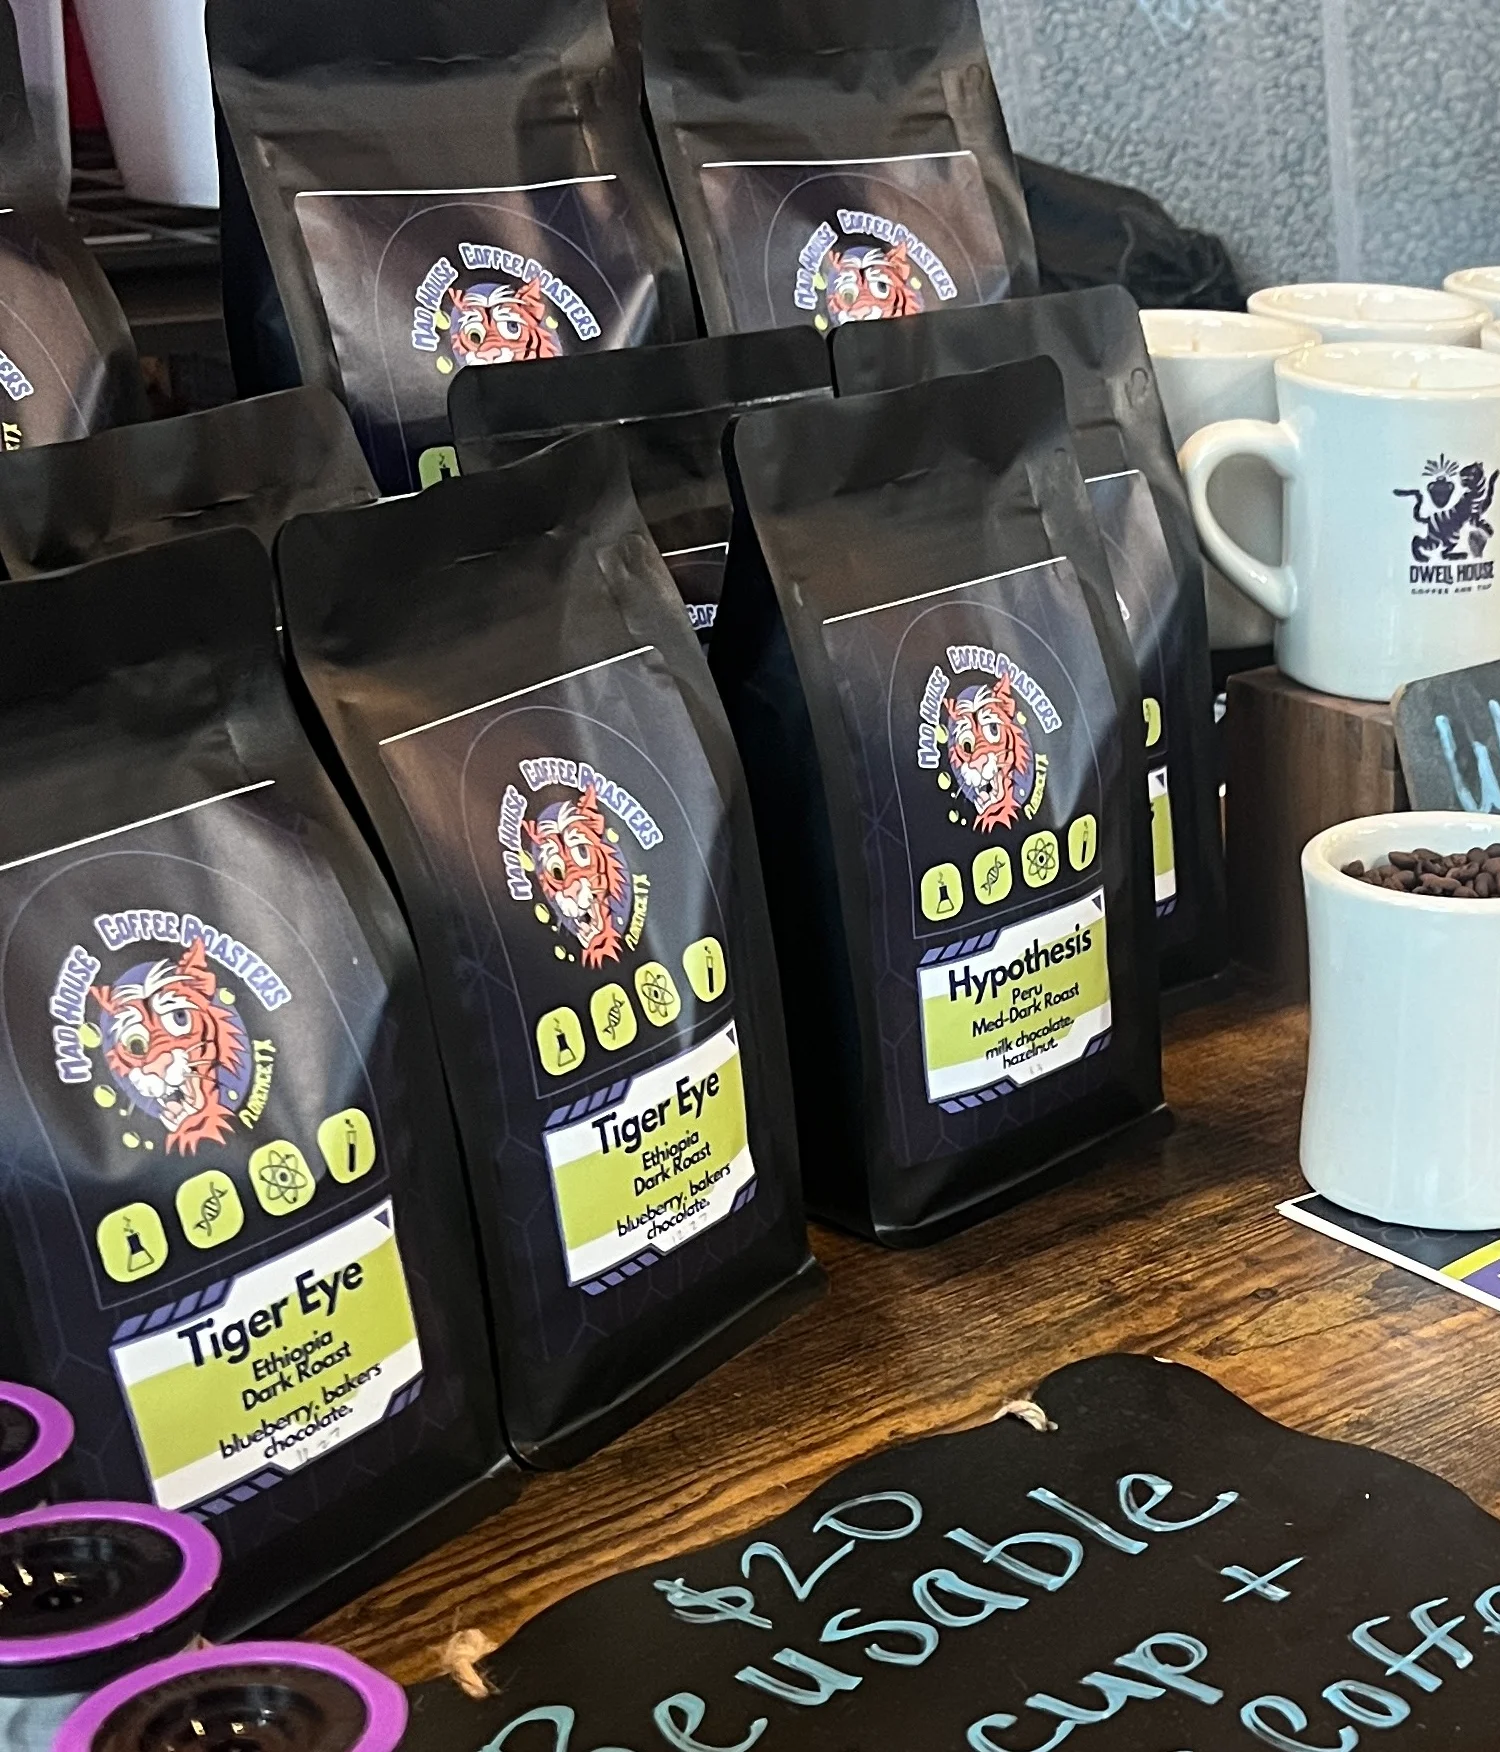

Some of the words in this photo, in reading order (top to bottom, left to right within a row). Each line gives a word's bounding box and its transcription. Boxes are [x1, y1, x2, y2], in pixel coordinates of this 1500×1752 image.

[415, 257, 459, 311] HOUSE
[458, 242, 525, 278] COFFEE
[522, 258, 602, 341] ROASTERS
[412, 306, 438, 351] MAD
[1409, 563, 1453, 585] DWELL
[1456, 561, 1494, 583] HOUSE
[946, 645, 997, 674] COFFEE
[920, 665, 950, 726] HOUSE
[994, 653, 1063, 734] ROASTERS
[918, 723, 940, 769] MAD
[519, 757, 579, 791] COFFEE
[498, 784, 528, 851] HOUSE
[577, 762, 664, 850] ROASTERS
[502, 850, 533, 900] MAD
[94, 909, 182, 951] COFFEE
[49, 945, 101, 1027] HOUSE
[180, 914, 292, 1012] ROASTERS
[949, 923, 1092, 1005] Hypothesis
[973, 999, 1042, 1037] Med-Dark
[1044, 982, 1080, 1009] Roast
[1012, 984, 1043, 1005] Peru
[53, 1025, 92, 1084] MAD
[986, 1037, 1014, 1060] milk
[591, 1098, 671, 1154] Tiger
[676, 1072, 720, 1119] Eye
[634, 1164, 670, 1197] Dark
[673, 1142, 712, 1176] Roast
[642, 1129, 700, 1172] Ethiopia
[689, 1163, 731, 1197] bakers
[178, 1298, 289, 1367] Tiger
[295, 1261, 364, 1317] Eye
[242, 1371, 294, 1411] Dark
[298, 1341, 352, 1383] Roast
[252, 1329, 333, 1382] Ethiopia
[321, 1363, 382, 1405] bakers
[653, 1490, 922, 1630] $20
[966, 1630, 1224, 1752] cup
